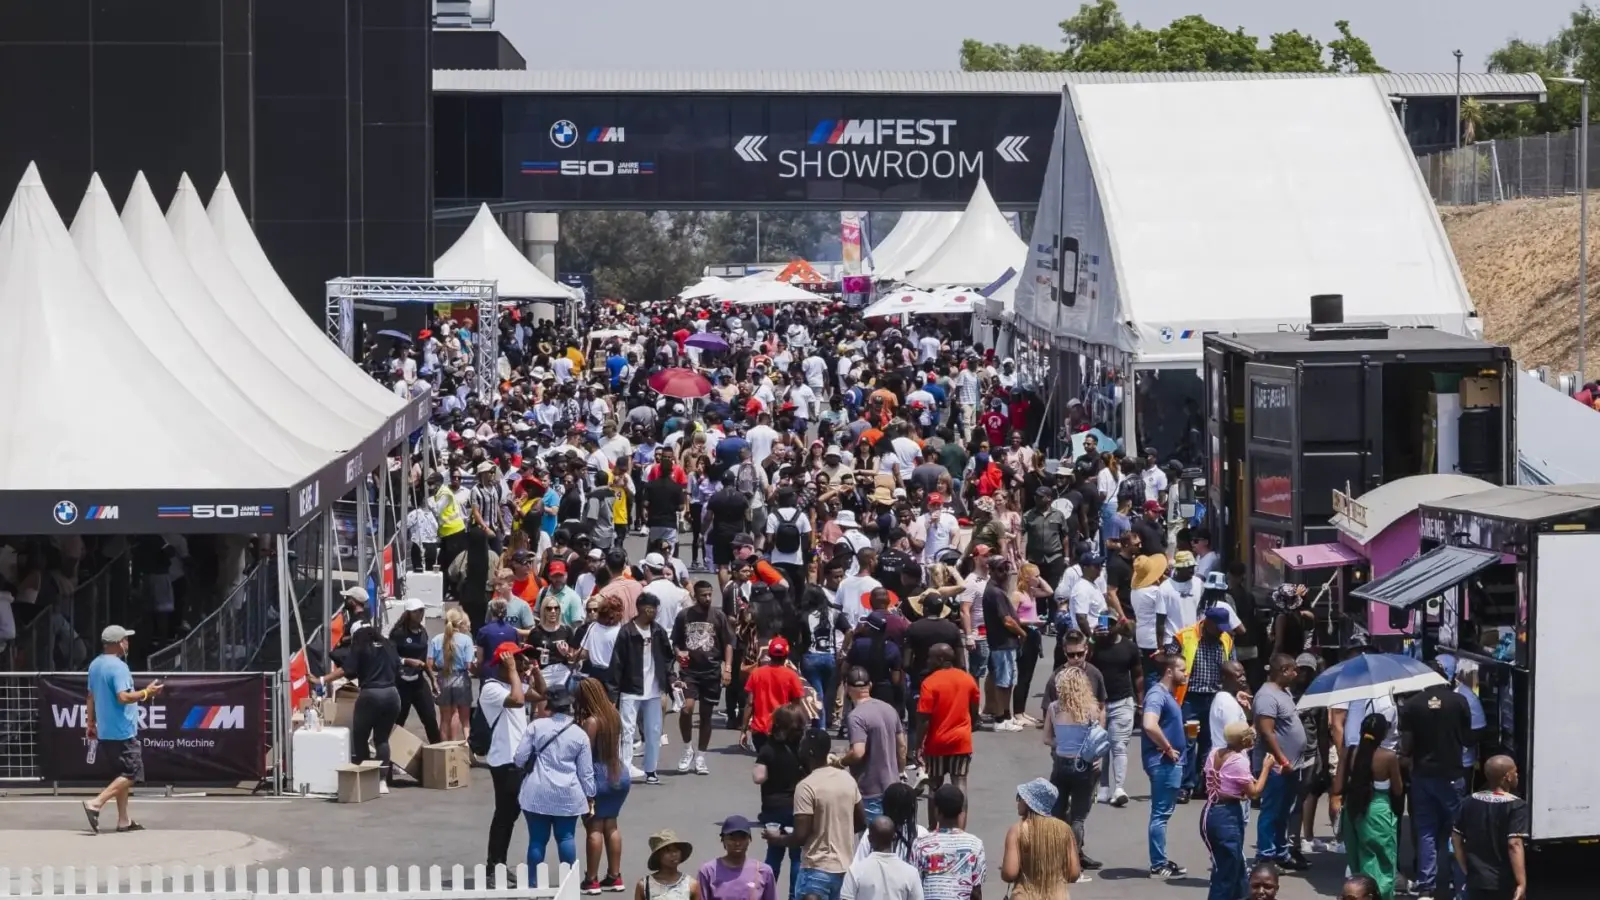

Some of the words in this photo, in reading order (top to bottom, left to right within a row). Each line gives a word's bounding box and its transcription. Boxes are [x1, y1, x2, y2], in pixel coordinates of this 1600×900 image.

[560, 160, 614, 176] 50
[778, 150, 984, 178] SHOWROOM
[192, 504, 239, 518] 50
[143, 738, 174, 749] Driving
[176, 738, 215, 748] Machine
